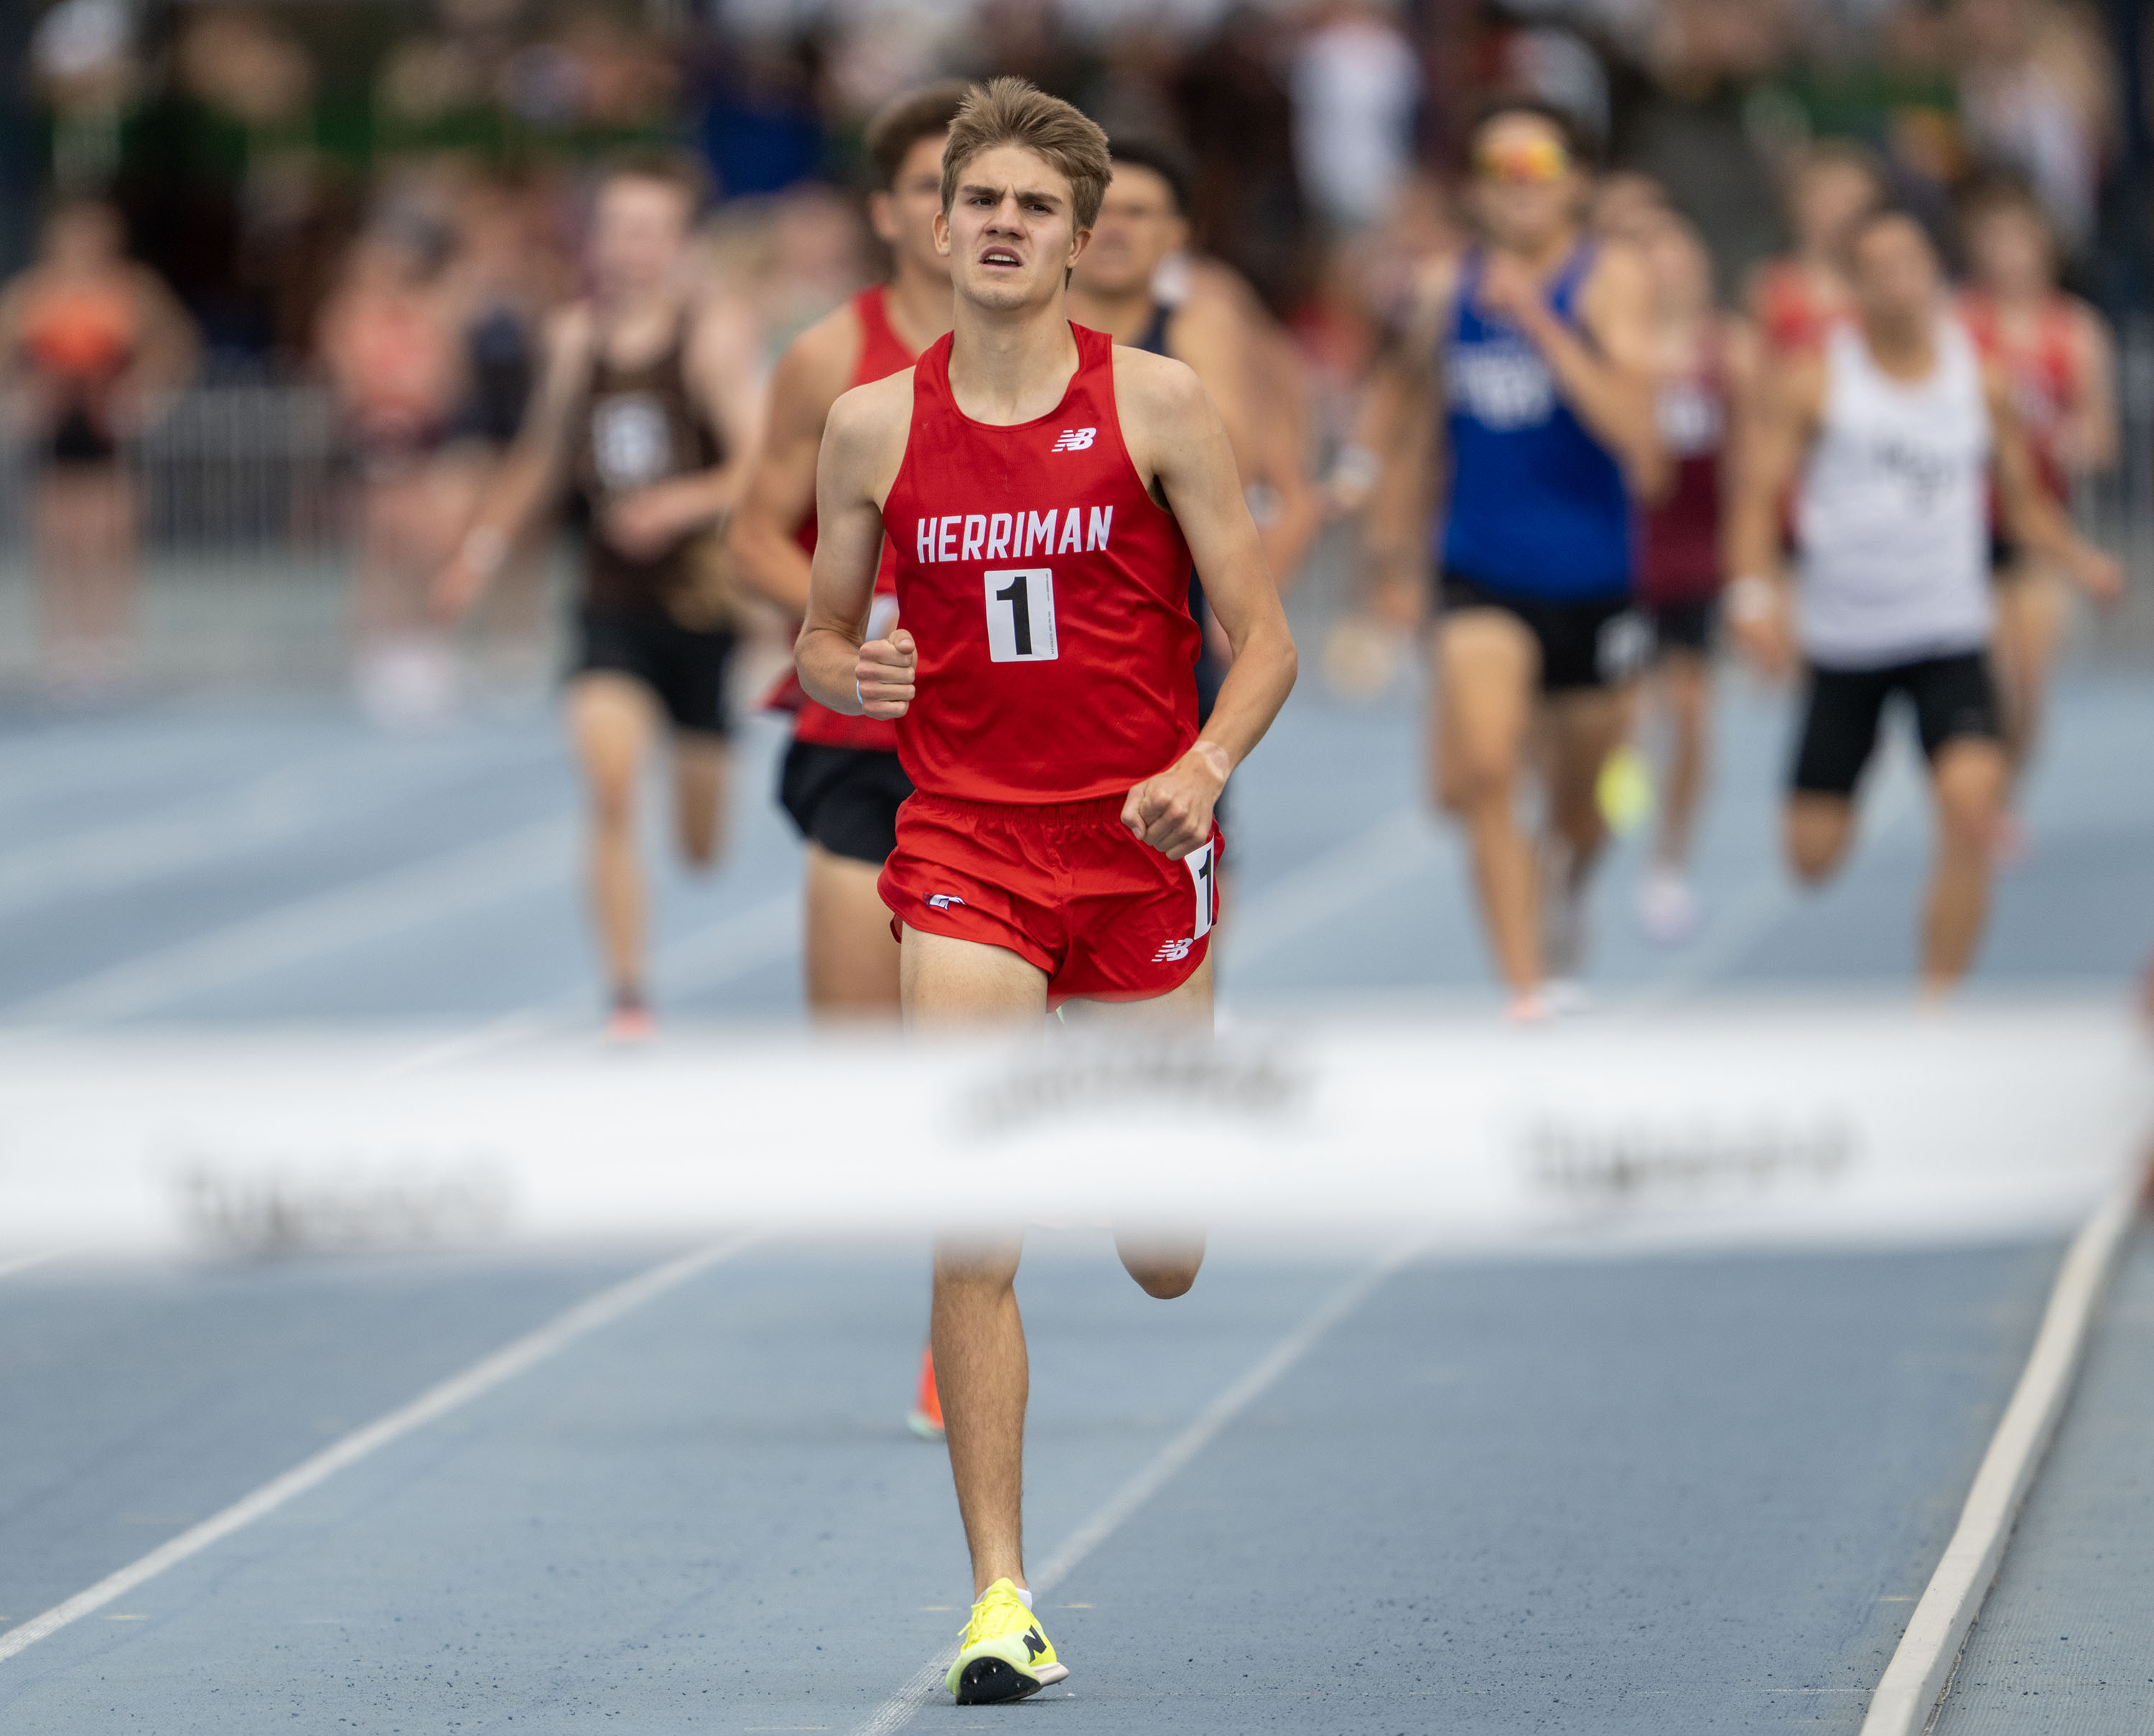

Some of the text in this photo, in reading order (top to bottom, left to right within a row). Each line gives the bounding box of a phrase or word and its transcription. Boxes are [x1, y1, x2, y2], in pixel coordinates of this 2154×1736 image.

[917, 505, 1113, 564] HERRIMAN
[996, 577, 1032, 655] 1
[1198, 848, 1212, 925] 1
